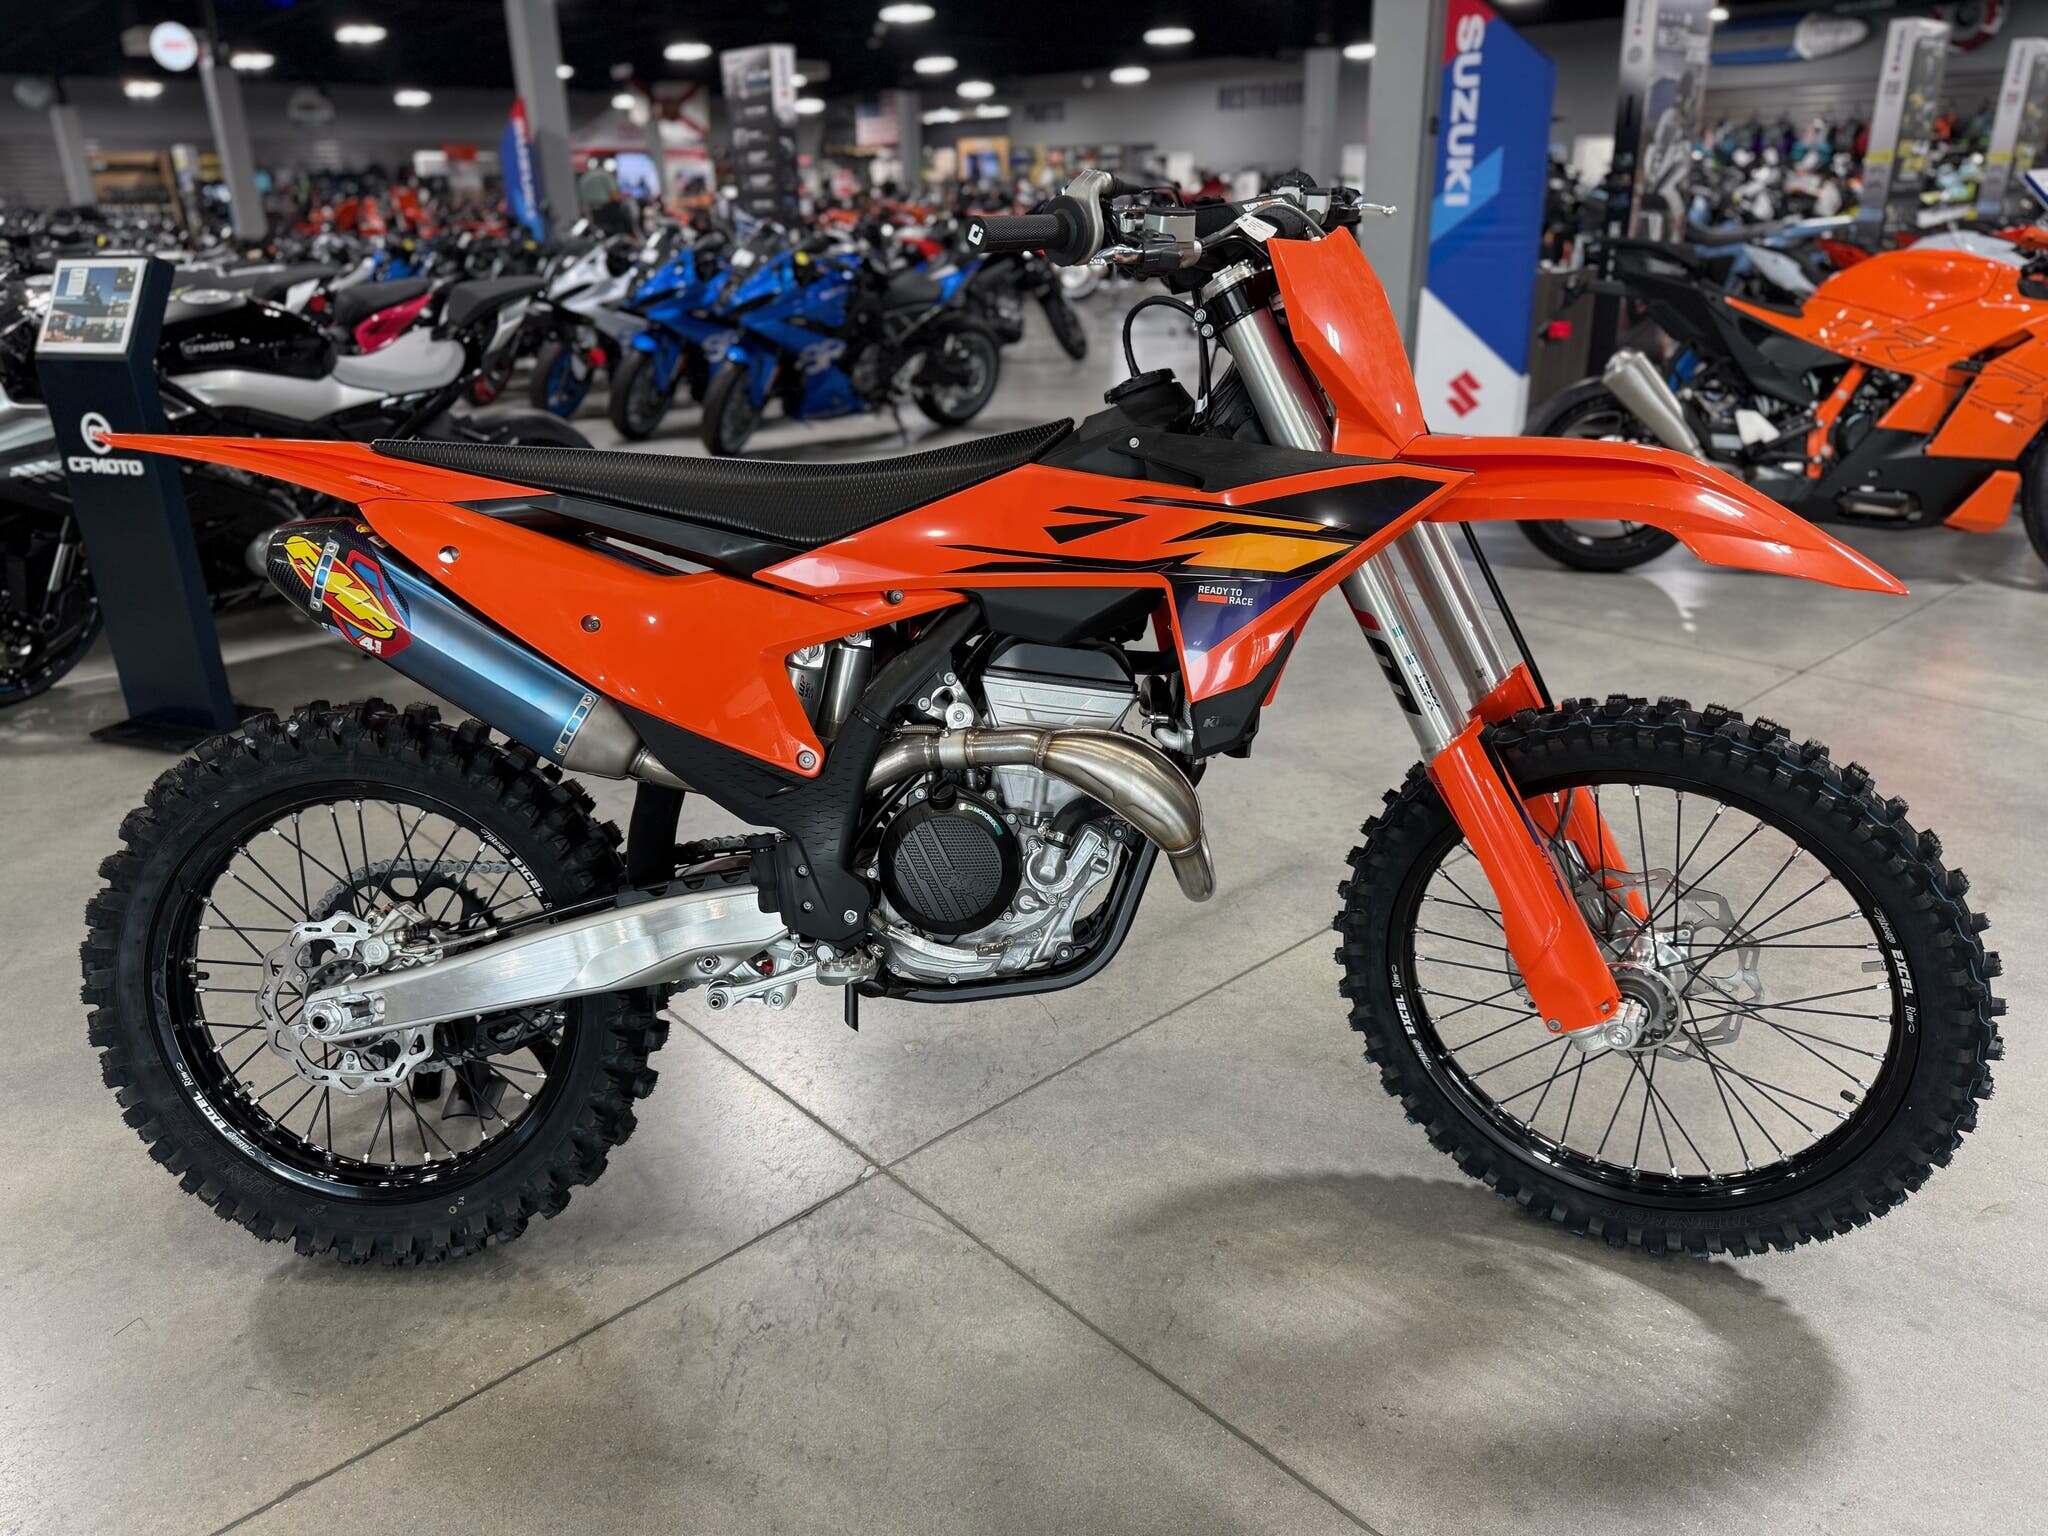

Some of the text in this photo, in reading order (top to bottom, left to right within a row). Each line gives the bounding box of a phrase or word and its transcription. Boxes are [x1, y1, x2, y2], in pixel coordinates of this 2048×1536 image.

[1443, 14, 1486, 207] SUZUKI
[67, 455, 145, 476] CFMOTO
[1198, 585, 1243, 597] READY TO
[1228, 596, 1254, 606] RACE
[973, 807, 998, 828] MOTOREX
[511, 856, 544, 897] EXCEL
[1891, 949, 1915, 998] EXCEL
[1396, 994, 1417, 1035] EXCEL
[193, 1091, 228, 1130] EXCEL
